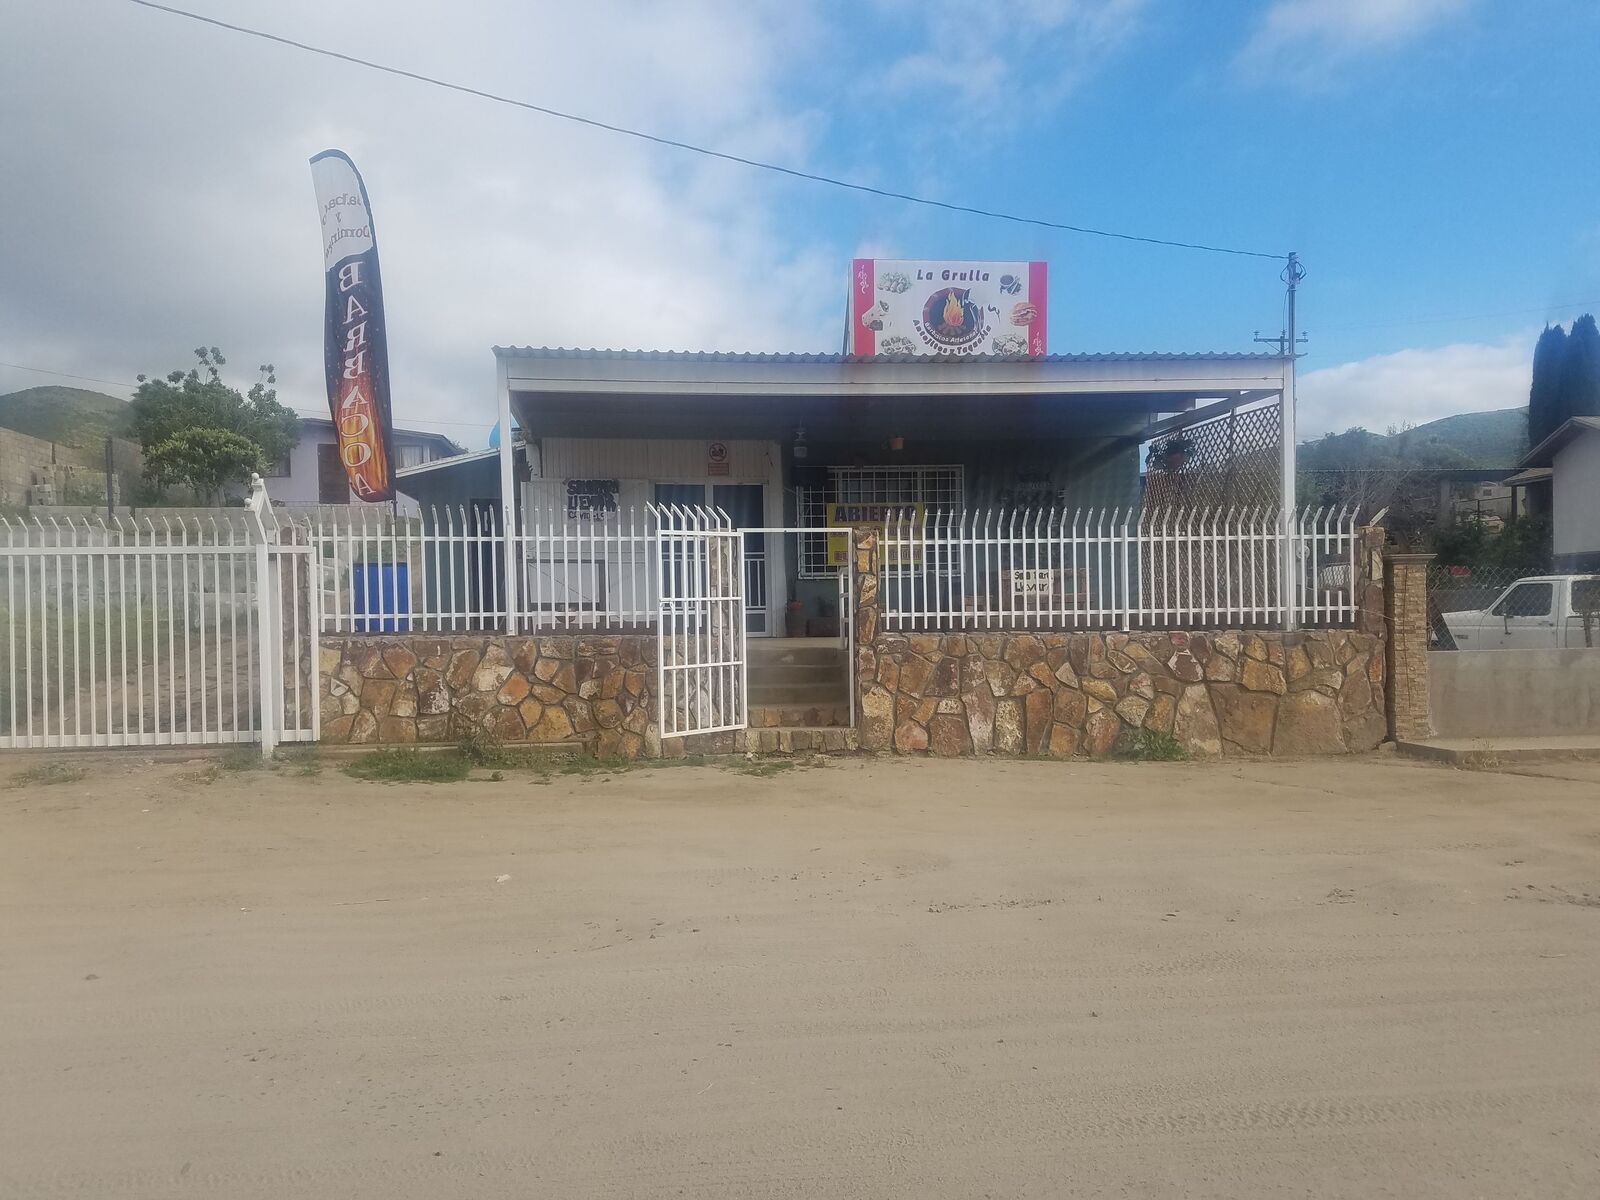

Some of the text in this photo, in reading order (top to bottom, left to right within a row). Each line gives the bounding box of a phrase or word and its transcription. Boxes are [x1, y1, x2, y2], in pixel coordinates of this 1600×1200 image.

[917, 269, 990, 281] La Grulla
[835, 506, 916, 522] ABIERTO
